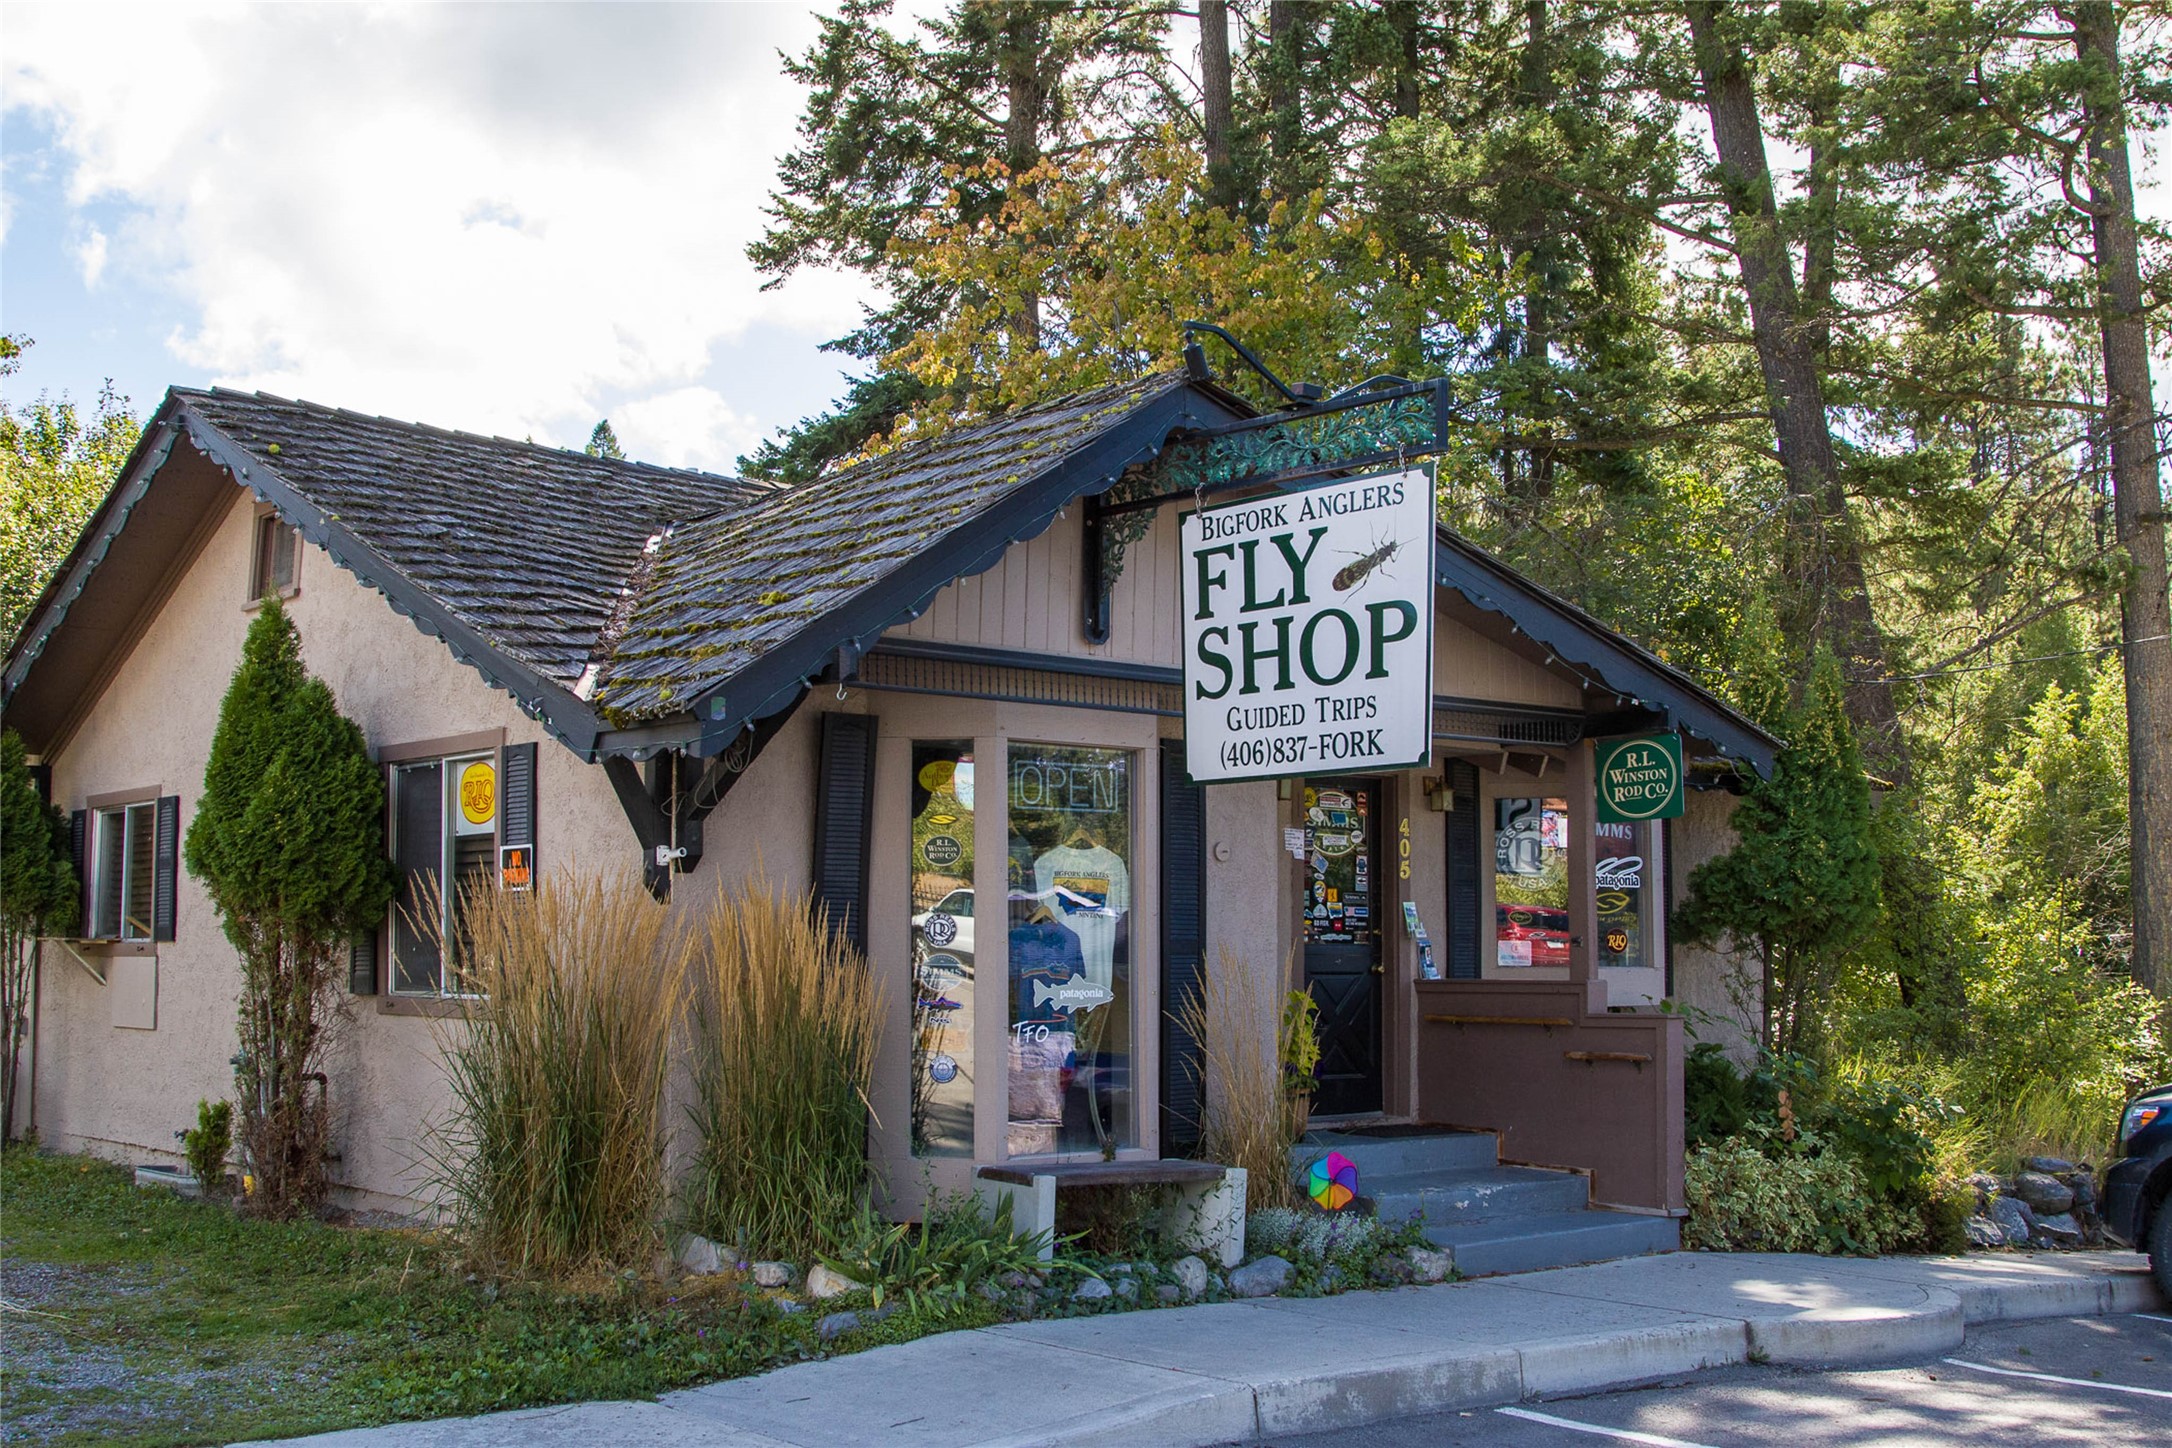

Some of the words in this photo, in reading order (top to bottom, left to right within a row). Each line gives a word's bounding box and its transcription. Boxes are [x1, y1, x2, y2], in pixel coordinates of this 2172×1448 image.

[1201, 504, 1288, 541] BIGFORK
[1298, 481, 1405, 522] ANGLERS
[1193, 526, 1328, 621] FLY
[1196, 599, 1418, 701] SHOP
[1226, 703, 1305, 731] GUIDED
[1315, 695, 1377, 723] TRIPS
[1220, 729, 1384, 770] (406)837-FORK
[1626, 750, 1656, 769] R.L.
[1019, 766, 1114, 809] OPEN
[1609, 768, 1668, 785] WINSTON
[464, 779, 495, 813] RIO
[1614, 785, 1643, 803] ROD
[1645, 781, 1669, 799] CO.
[1399, 817, 1411, 880] 405
[1497, 822, 1525, 859] ROSS
[511, 850, 522, 867] NO
[929, 852, 944, 860] ROD
[1518, 878, 1547, 889] USA
[925, 915, 939, 932] ROSS
[940, 914, 957, 932] REELS
[1608, 935, 1627, 950] RIO
[1060, 988, 1104, 1000] patagonia
[1012, 1020, 1050, 1043] TFO
